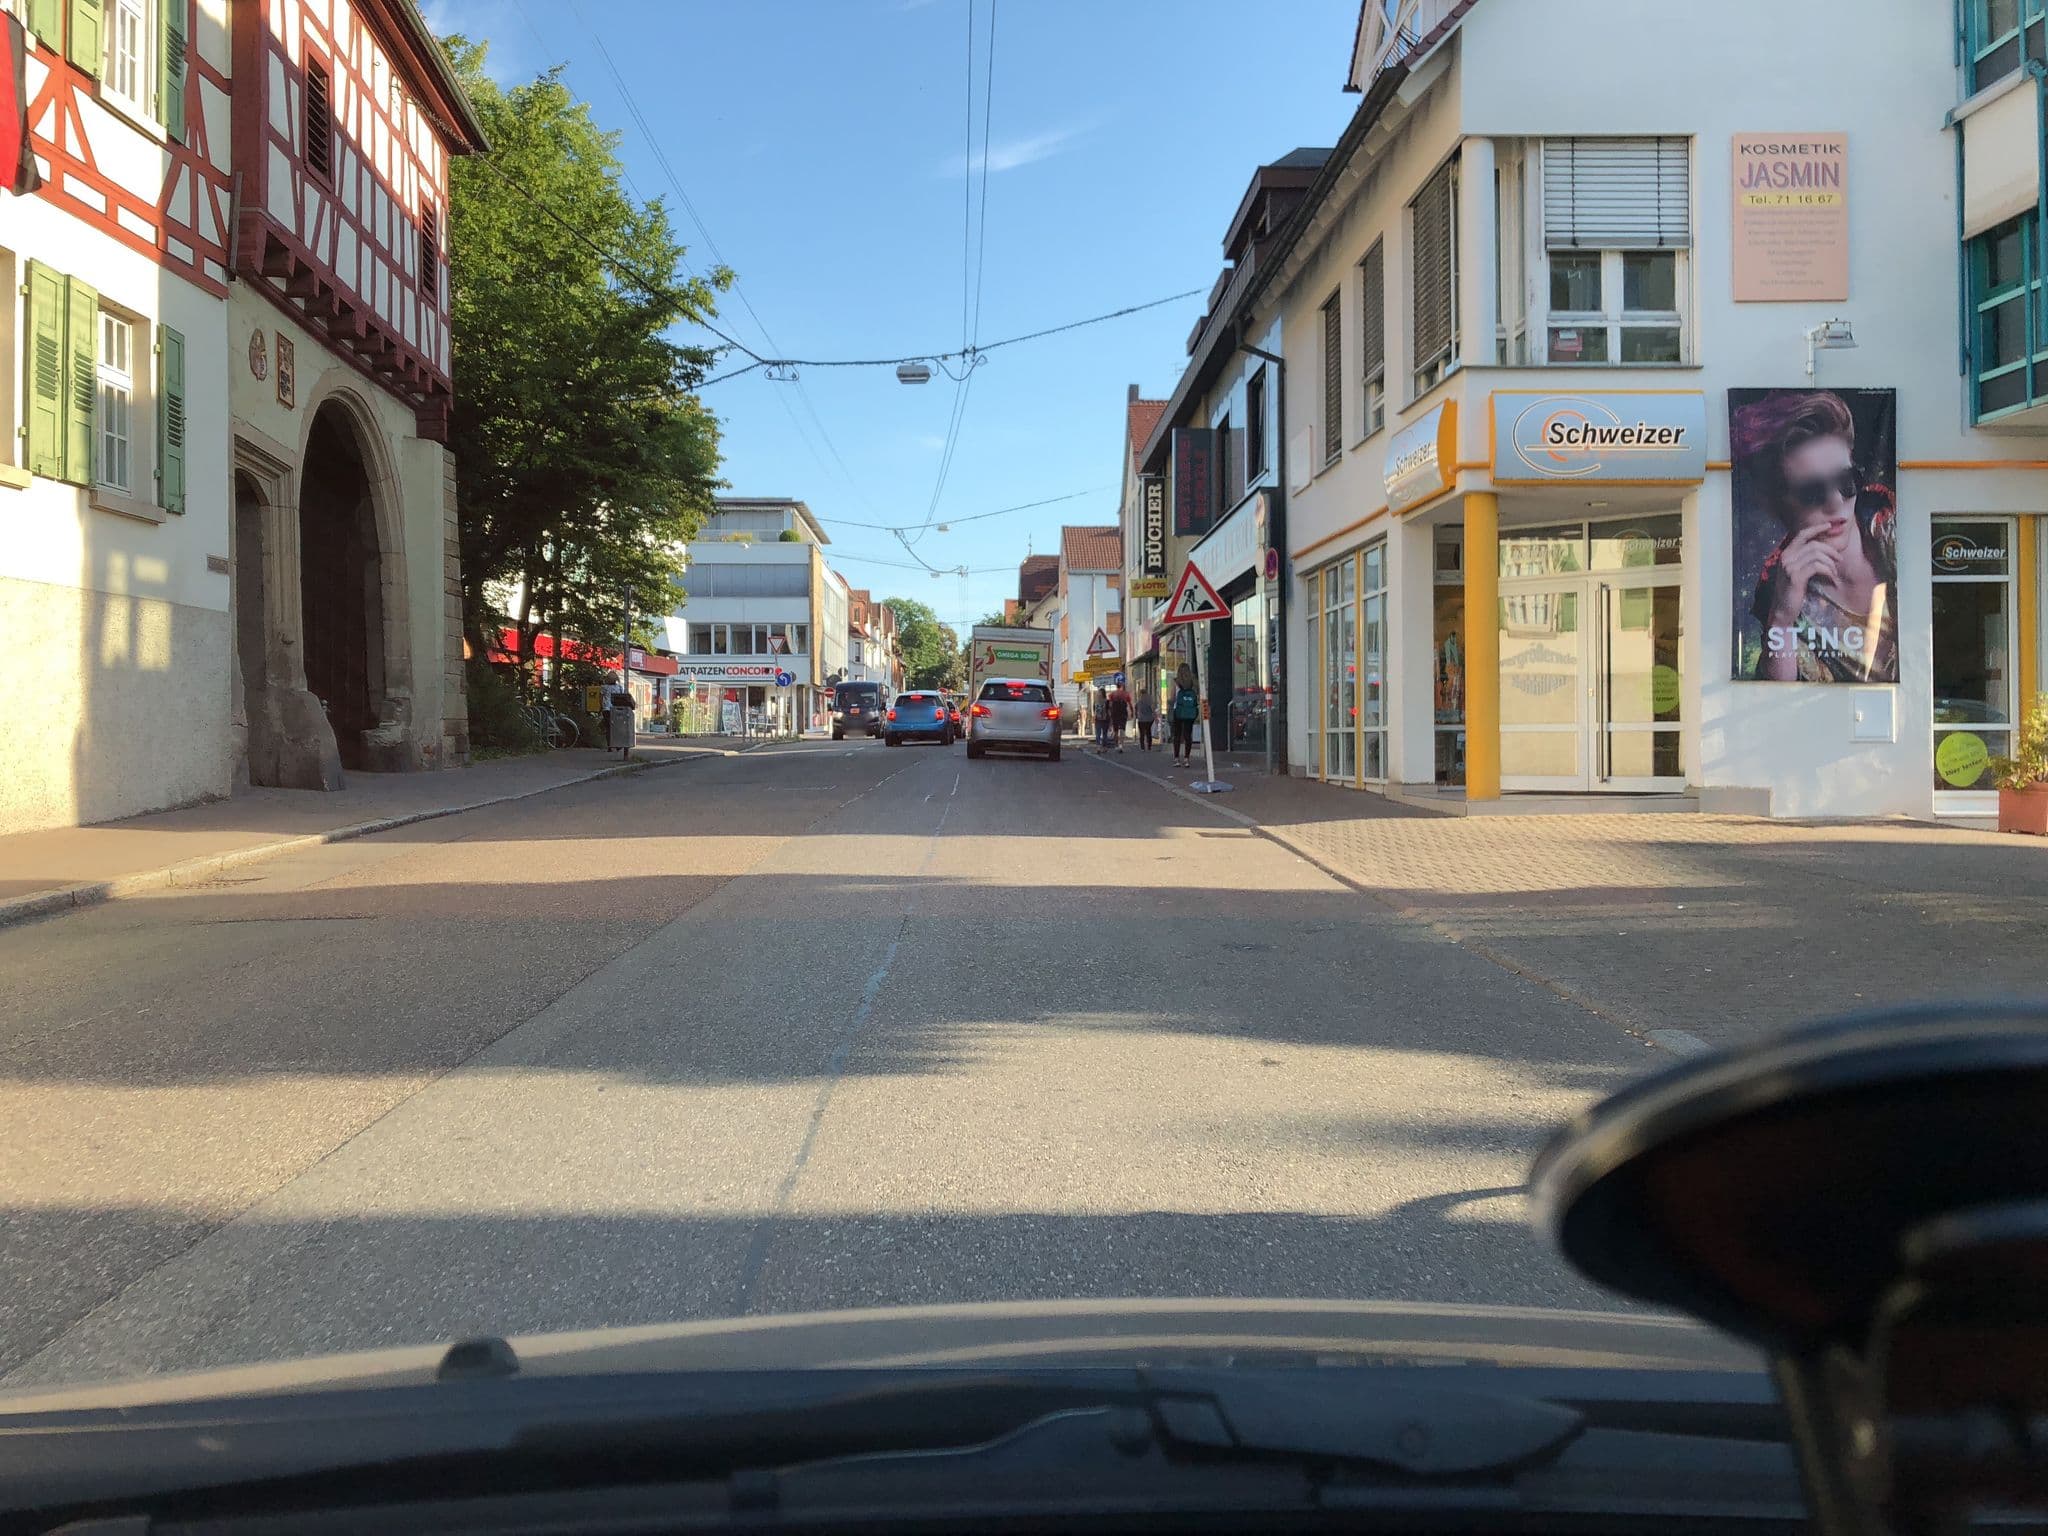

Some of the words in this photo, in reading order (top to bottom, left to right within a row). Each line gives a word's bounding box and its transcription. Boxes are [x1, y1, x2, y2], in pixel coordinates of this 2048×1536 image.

[1740, 143, 1841, 155] KOSMETIK
[1740, 161, 1840, 188] JASMIN
[1749, 195, 1772, 204] Tel.
[1777, 195, 1790, 204] 71
[1800, 195, 1813, 204] 16
[1818, 195, 1833, 204] 67
[1548, 421, 1686, 446] Schweizer
[1394, 441, 1432, 478] Schweizer
[1146, 483, 1163, 569] BÜCHER
[1945, 546, 2006, 558] Schweizer
